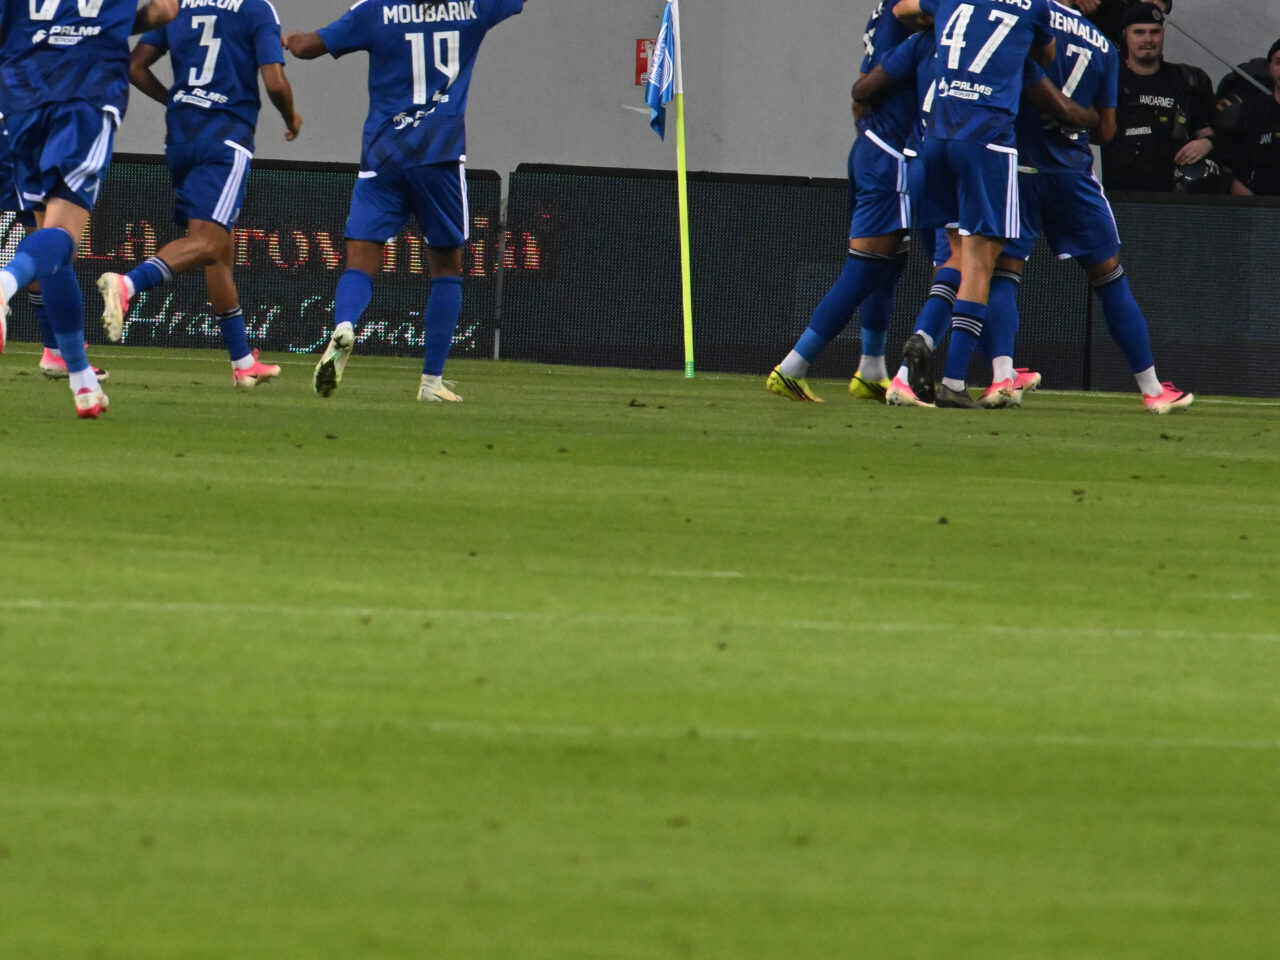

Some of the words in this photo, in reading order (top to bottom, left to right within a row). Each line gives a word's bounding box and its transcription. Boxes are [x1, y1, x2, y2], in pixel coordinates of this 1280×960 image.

[382, 0, 477, 25] MOUBARIK
[940, 3, 1020, 74] 47
[188, 15, 222, 86] 3
[404, 30, 460, 105] 19
[1065, 43, 1093, 98] 7
